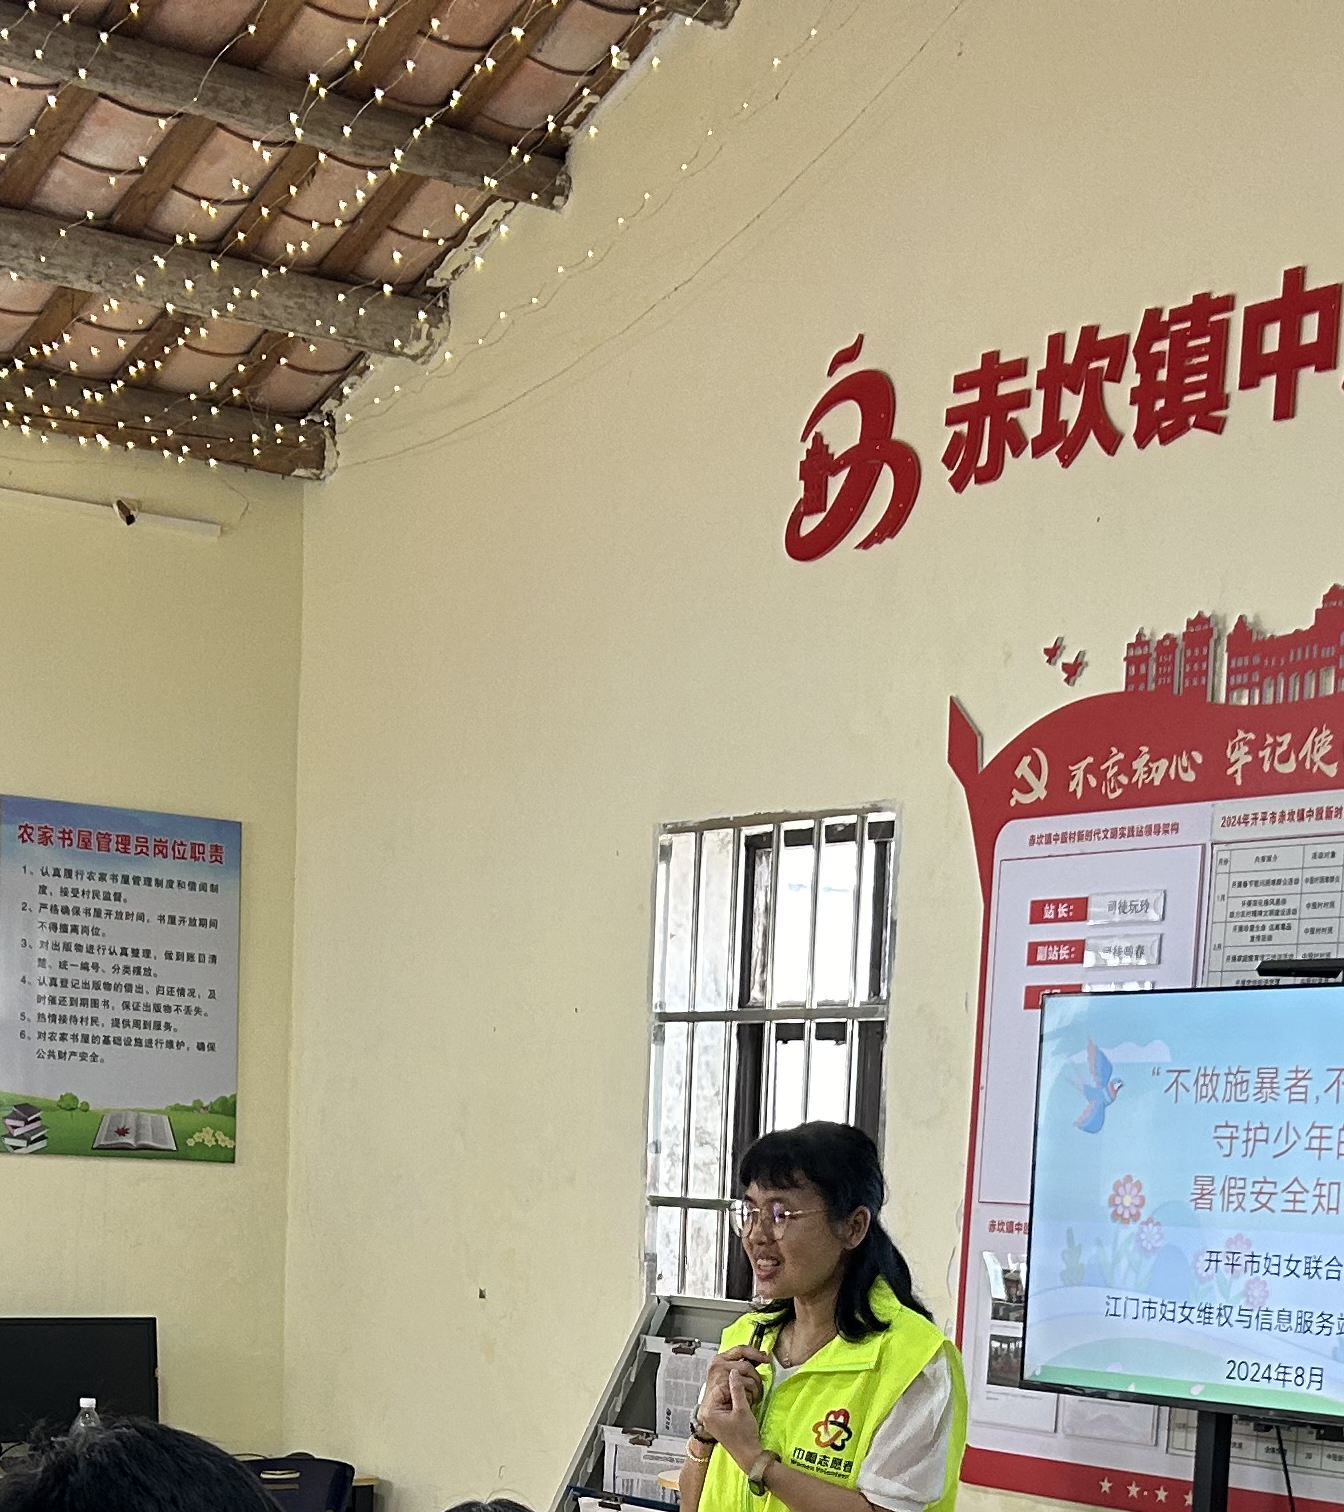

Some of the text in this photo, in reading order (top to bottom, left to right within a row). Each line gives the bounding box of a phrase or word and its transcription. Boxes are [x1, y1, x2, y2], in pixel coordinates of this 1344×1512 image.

[1069, 745, 1203, 799] 不忘初心
[17, 822, 224, 865] 农家书屋管理员岗位职责
[1226, 1358, 1325, 1391] 2024年8月
